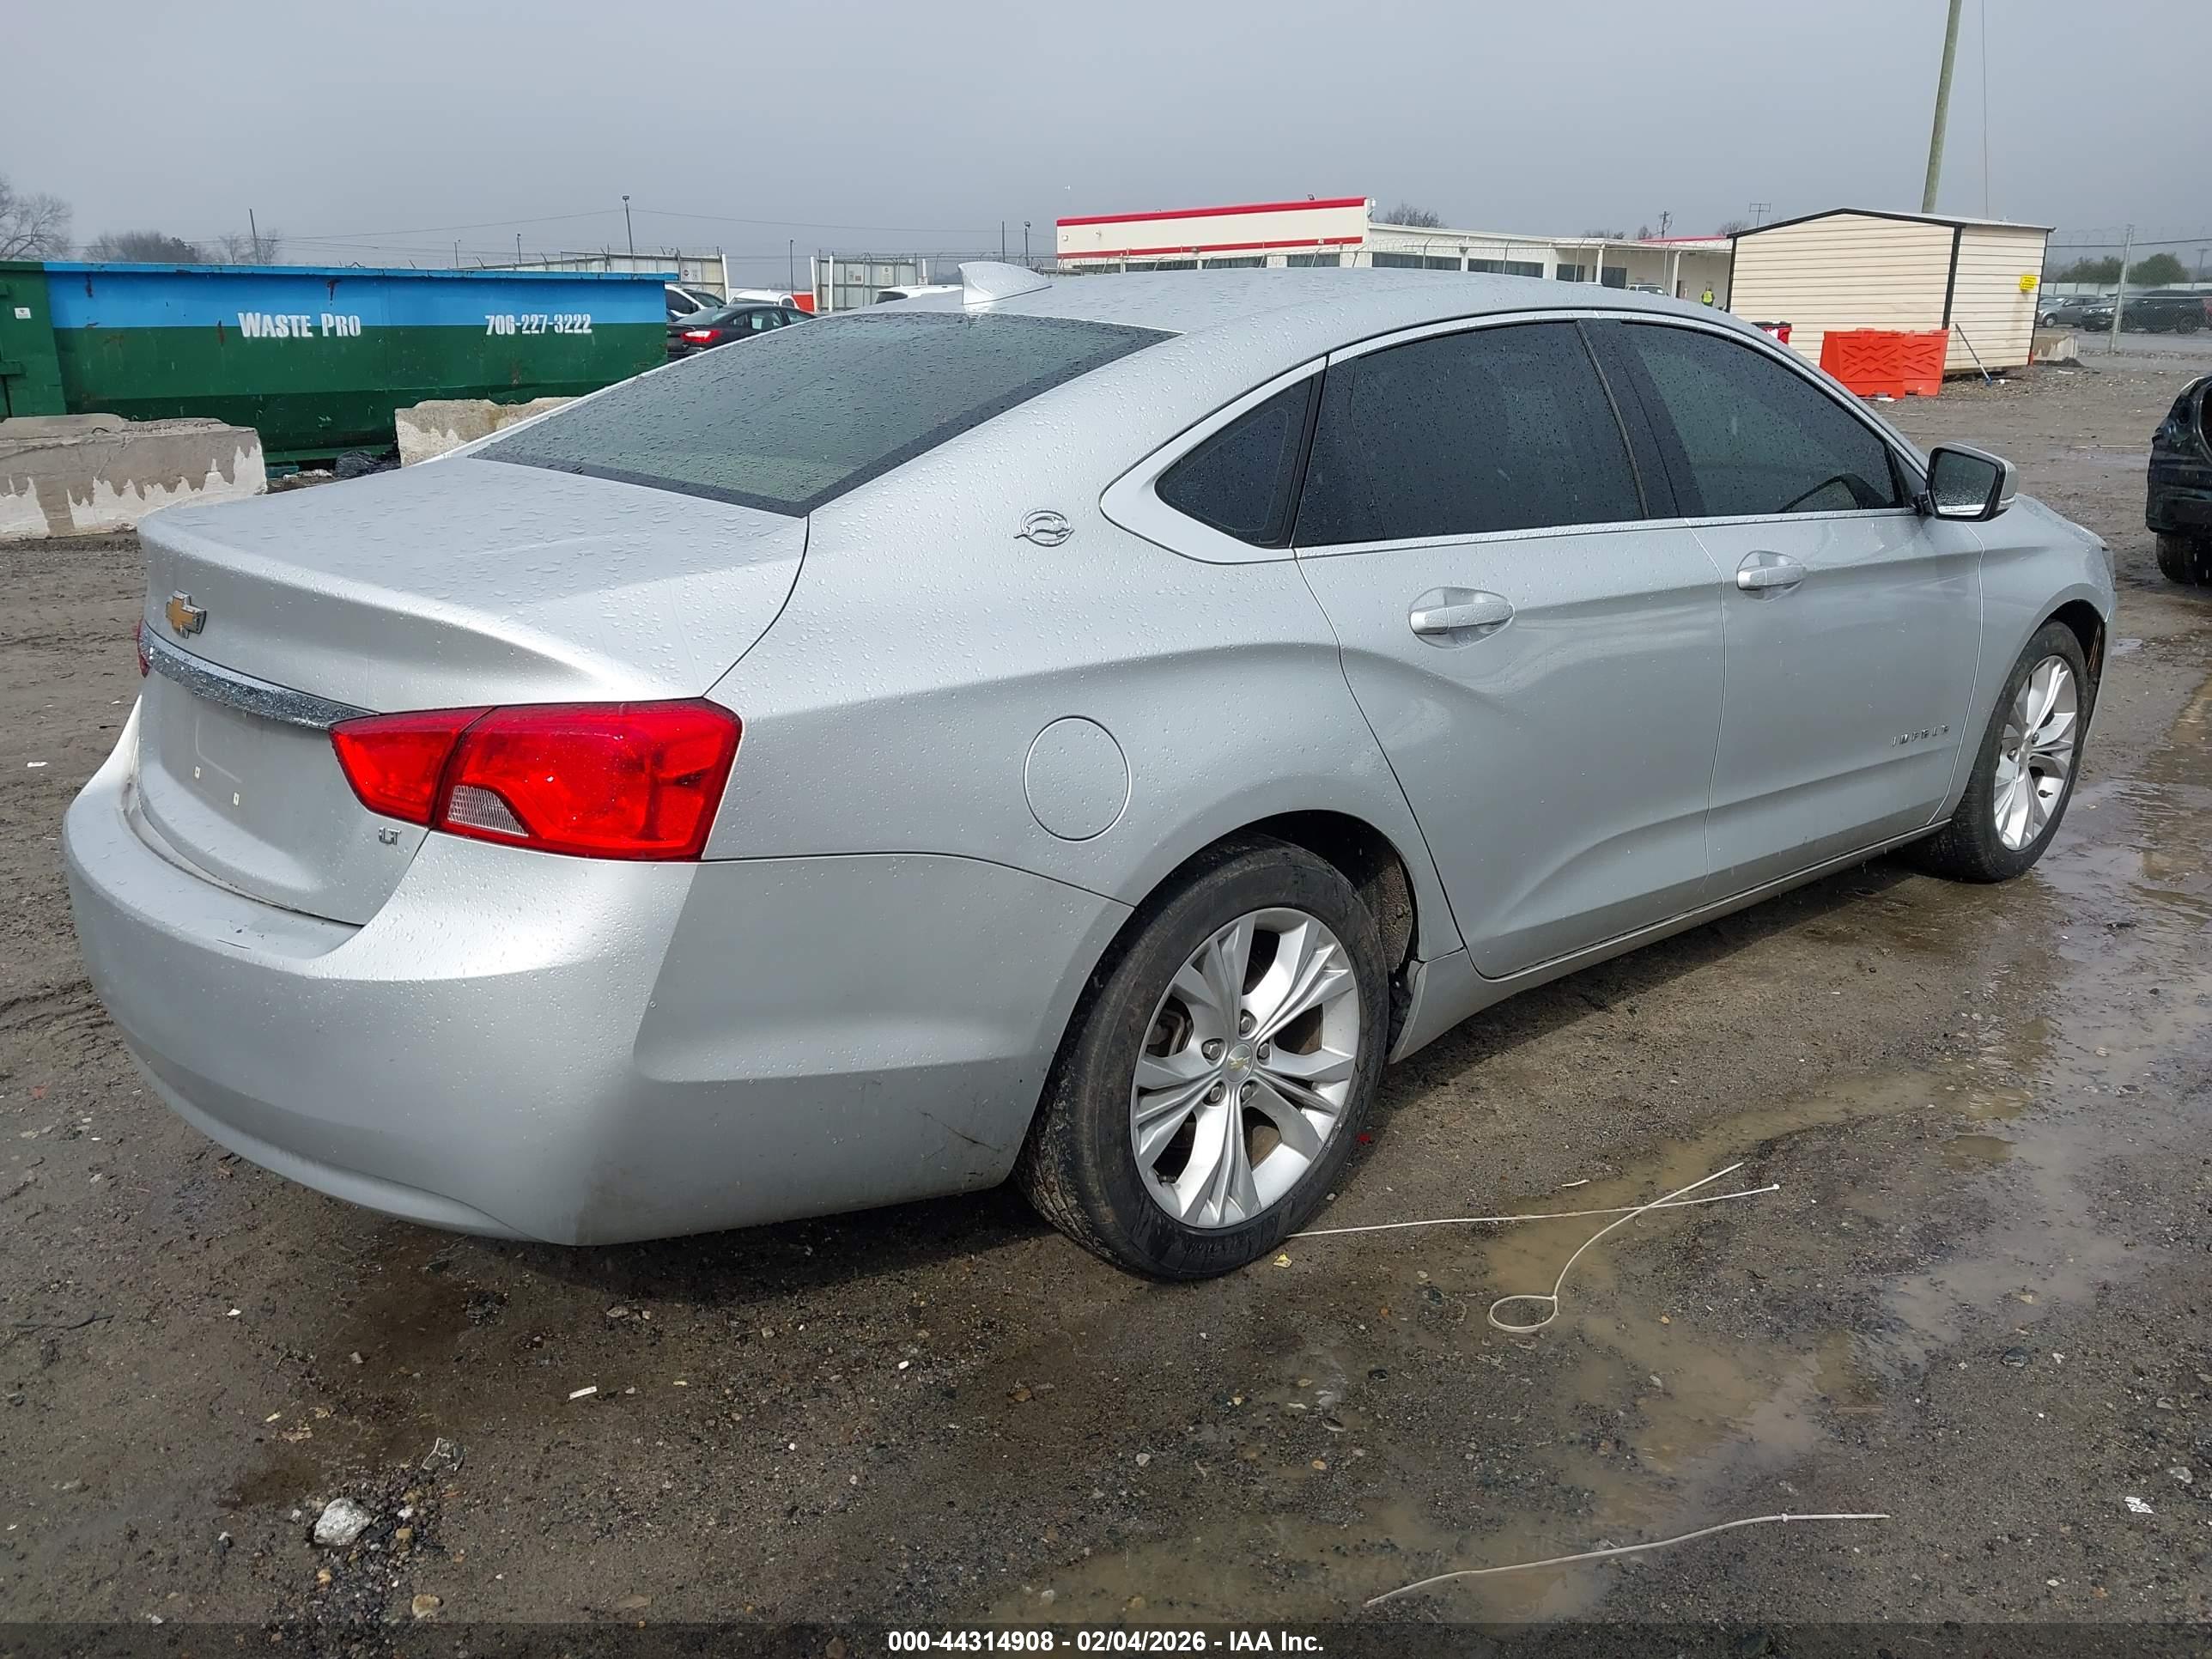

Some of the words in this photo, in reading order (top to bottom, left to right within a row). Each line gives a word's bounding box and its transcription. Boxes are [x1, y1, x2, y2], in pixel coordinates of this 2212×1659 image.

[237, 312, 314, 337] WASTE
[320, 313, 362, 337] PRO
[484, 313, 592, 336] 706-227-3222
[378, 826, 402, 846] LT
